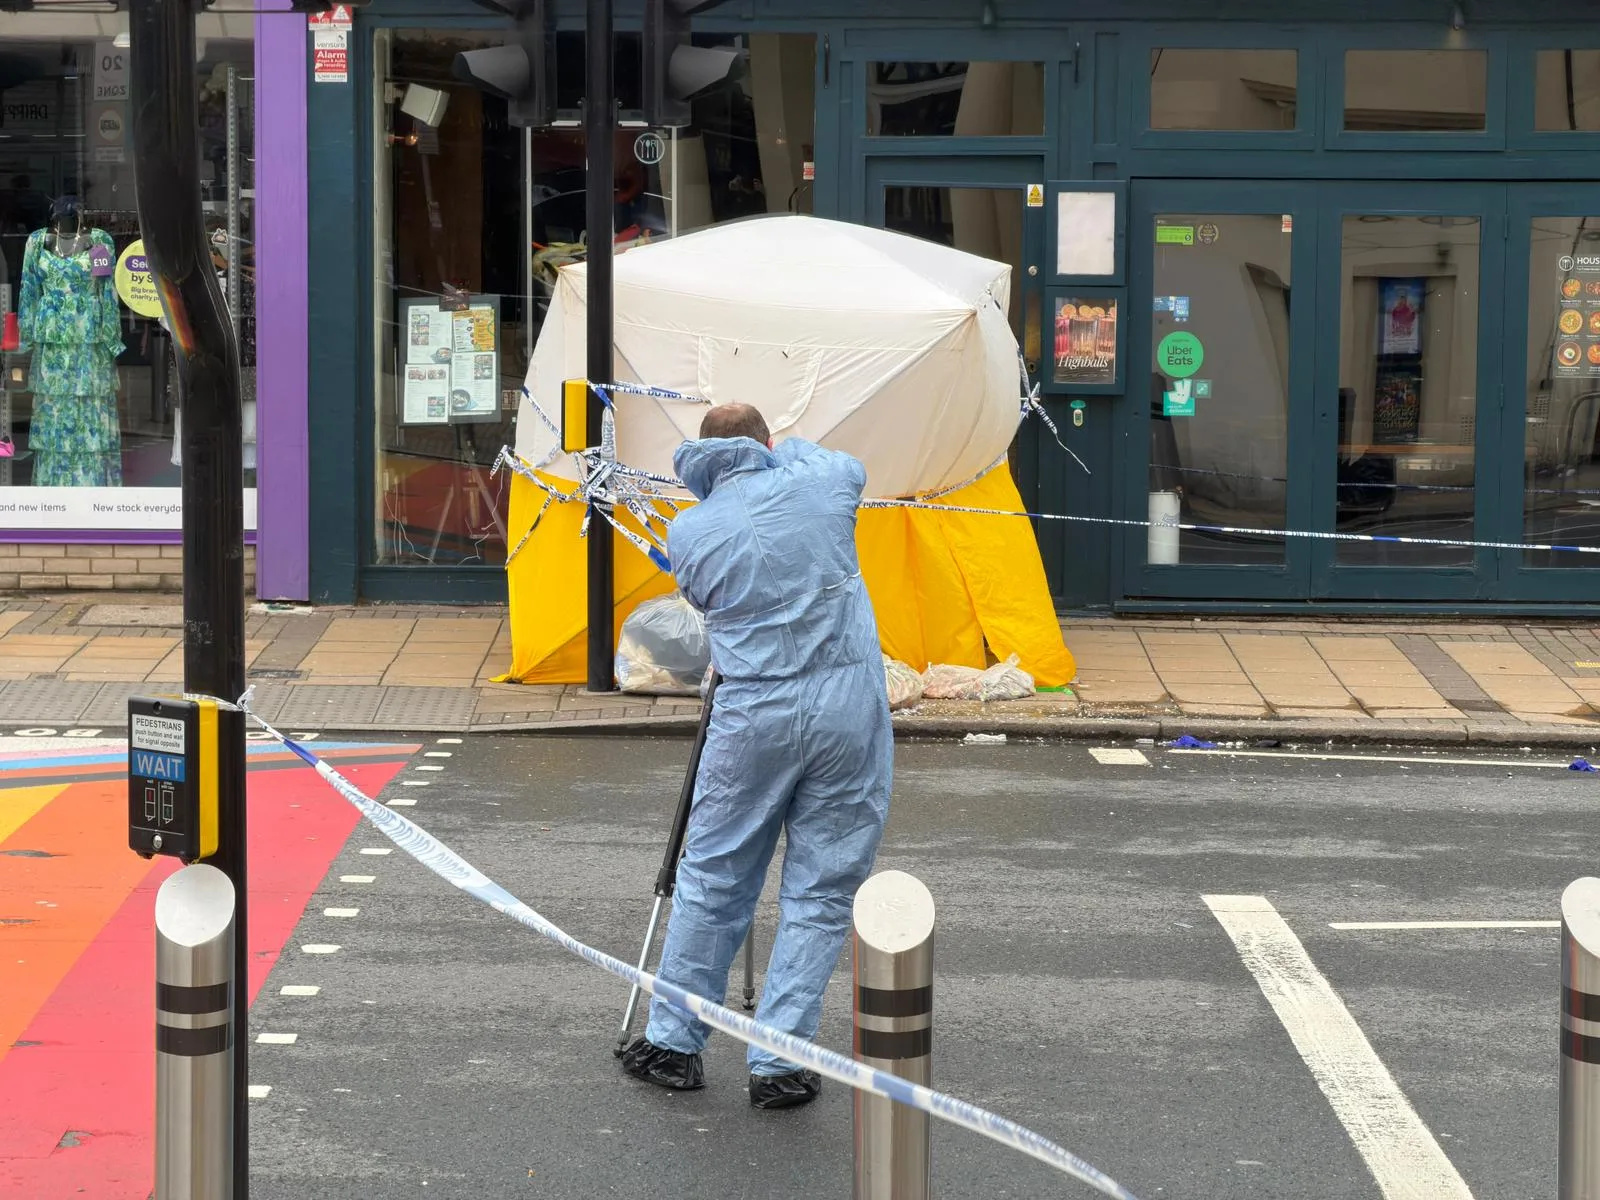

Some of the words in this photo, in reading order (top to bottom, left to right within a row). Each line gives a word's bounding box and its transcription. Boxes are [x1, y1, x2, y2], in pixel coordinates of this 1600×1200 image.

[317, 51, 346, 59] Alarm
[93, 258, 108, 267] £10
[131, 273, 144, 284] by
[131, 293, 152, 301] charity
[1167, 345, 1193, 355] Uber
[1058, 355, 1109, 369] Highballs
[1167, 356, 1194, 366] Eats
[18, 504, 38, 512] new
[41, 502, 66, 512] items
[93, 503, 114, 512] New
[117, 503, 141, 512] stock
[144, 503, 183, 514] everyda
[136, 717, 182, 731] PEDESTRIANS
[145, 737, 159, 746] signal
[160, 740, 180, 749] opposite
[137, 753, 182, 779] WAIT
